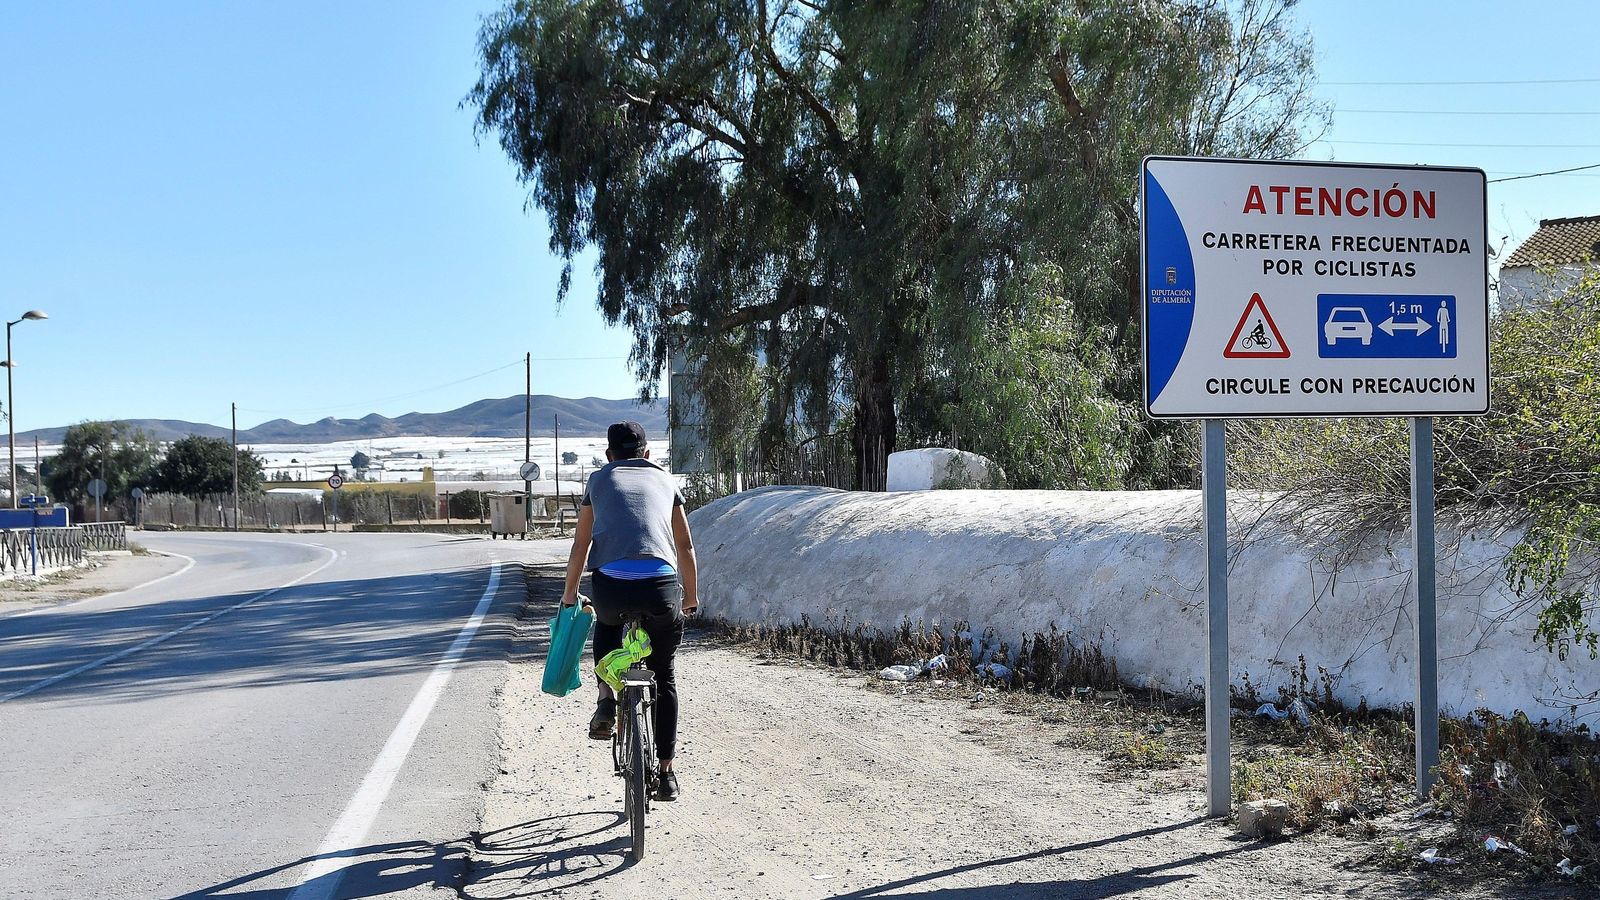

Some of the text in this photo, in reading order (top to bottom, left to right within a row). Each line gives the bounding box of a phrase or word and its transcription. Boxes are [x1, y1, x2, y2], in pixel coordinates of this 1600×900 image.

[1242, 183, 1437, 219] ATENCIÓN
[1202, 231, 1471, 254] CARRETERA FRECUENTADA
[1263, 259, 1417, 277] POR CICLISTAS
[1389, 301, 1423, 315] 1,5 m
[1205, 374, 1476, 395] CIRCULE CON PRECAUCIÓN
